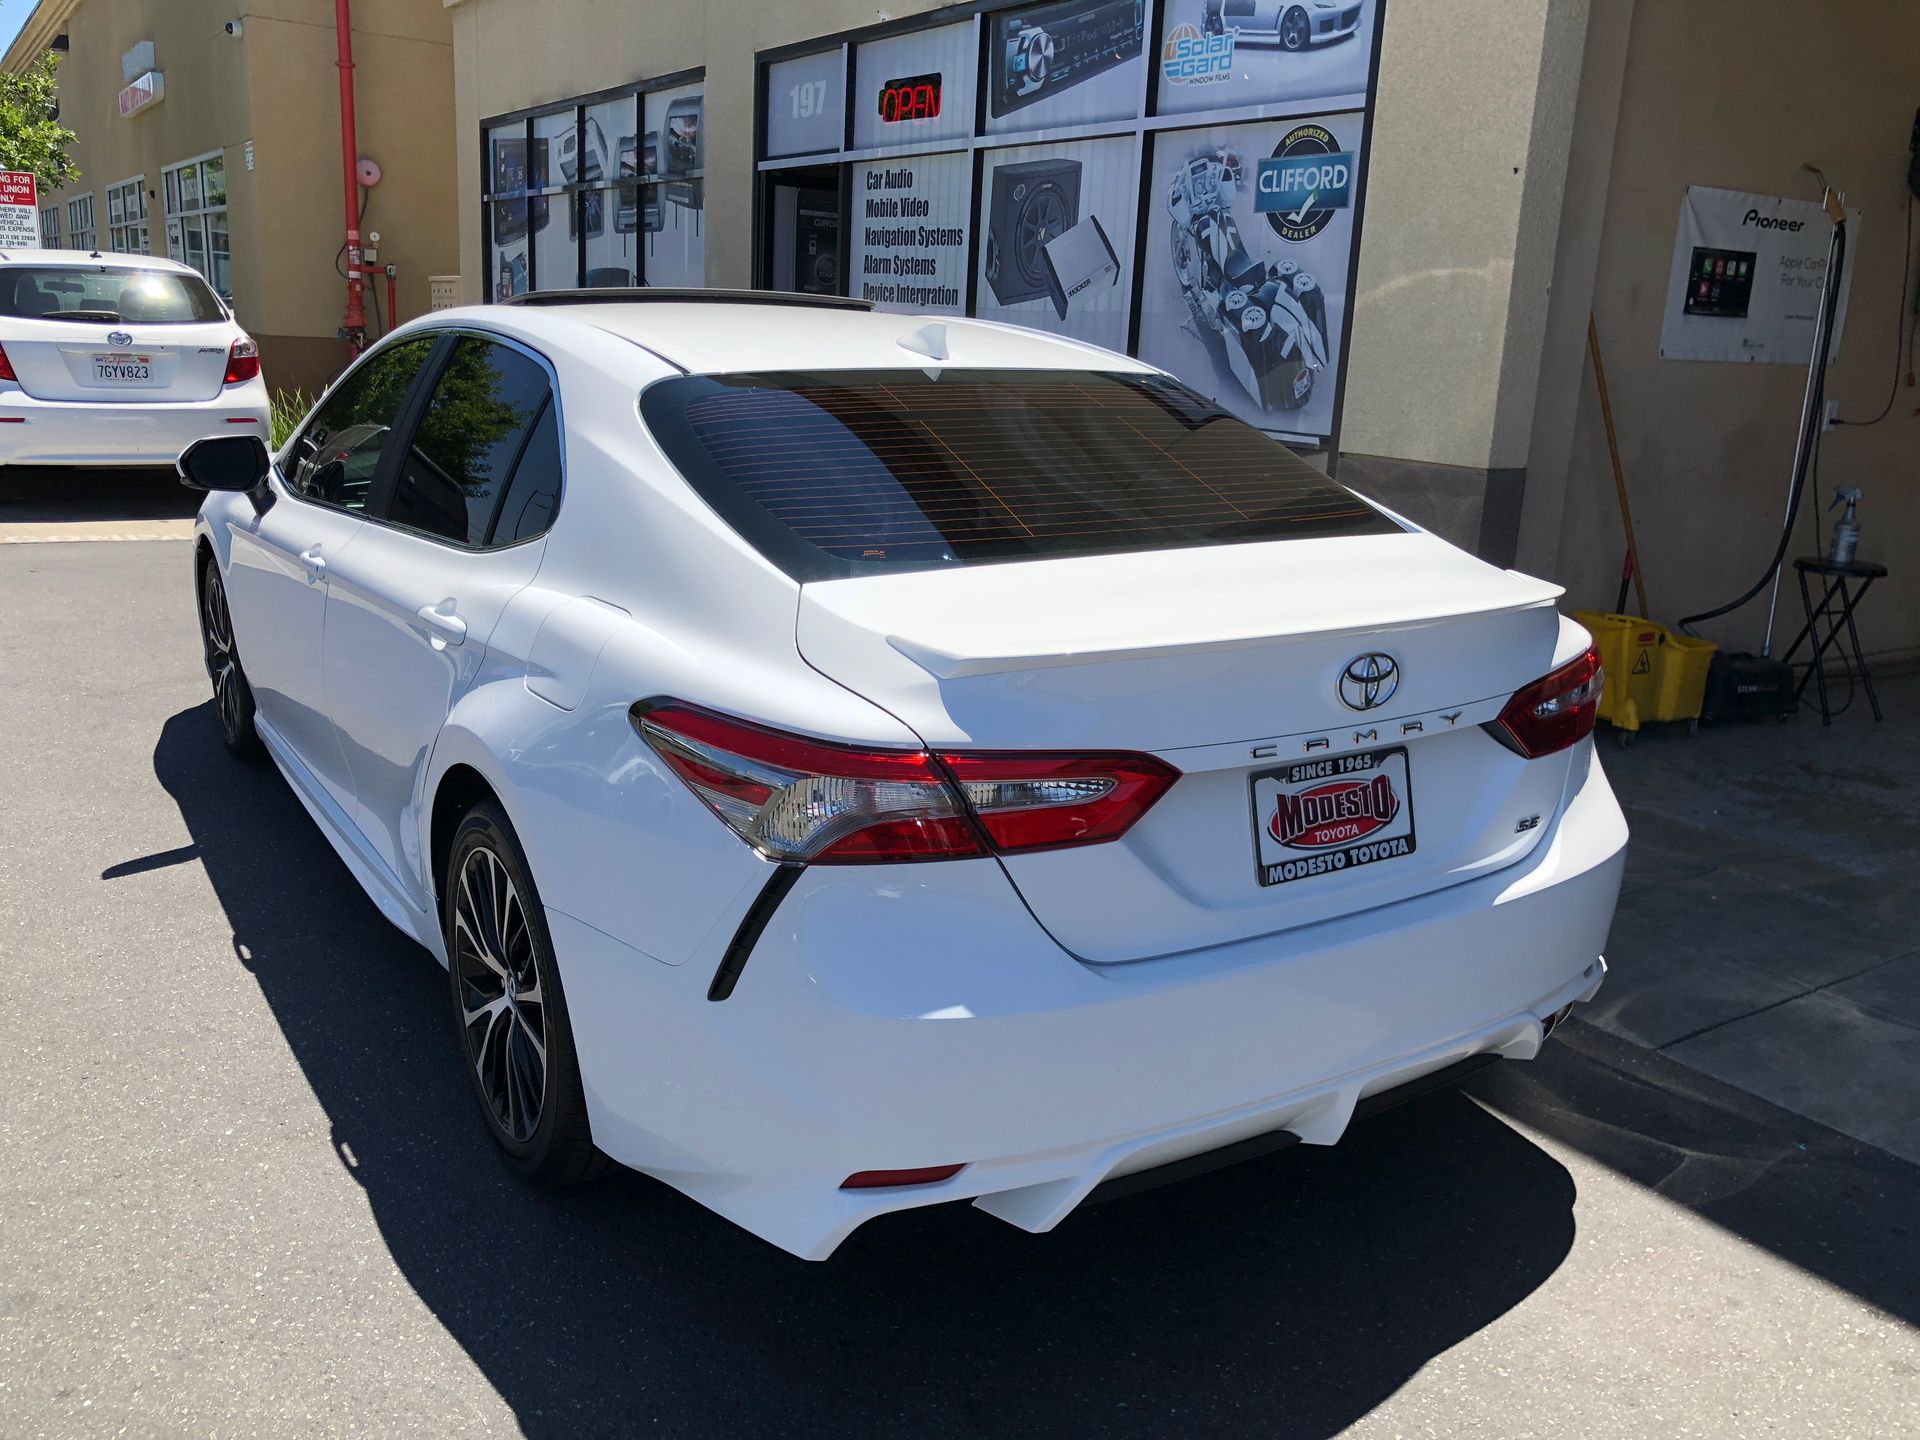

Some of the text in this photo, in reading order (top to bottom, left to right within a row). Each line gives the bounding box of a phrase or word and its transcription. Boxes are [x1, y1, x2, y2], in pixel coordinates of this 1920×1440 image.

[1176, 32, 1234, 59] Solar
[1180, 41, 1233, 77] Gard
[1189, 73, 1231, 85] WINDOW FILMS
[790, 80, 826, 119] 197
[883, 85, 942, 123] OPEN
[1284, 128, 1329, 146] AUTHORIZED
[3, 185, 29, 193] UNION
[13, 176, 30, 184] FOR
[866, 169, 913, 190] Car Audio
[1259, 164, 1348, 193] CLIFFORD
[865, 197, 929, 219] Mobile Video
[1742, 209, 1805, 232] Pioneer
[864, 226, 963, 248] Navigation Systems
[1282, 225, 1317, 239] DEALER
[863, 255, 936, 276] Alarm Systems
[1779, 255, 1803, 271] Apple
[1780, 273, 1795, 287] For
[1796, 274, 1815, 288] Your
[863, 282, 958, 306] Device Intergration
[97, 365, 149, 379] 7GYV823
[1250, 711, 1463, 759] CAMRY
[1291, 754, 1371, 782] SINCE 1965
[1276, 774, 1393, 844] MODESTO
[1315, 824, 1359, 843] TOYOTA
[1514, 815, 1541, 833] SE
[1268, 838, 1409, 884] MODESTO TOYOTA
